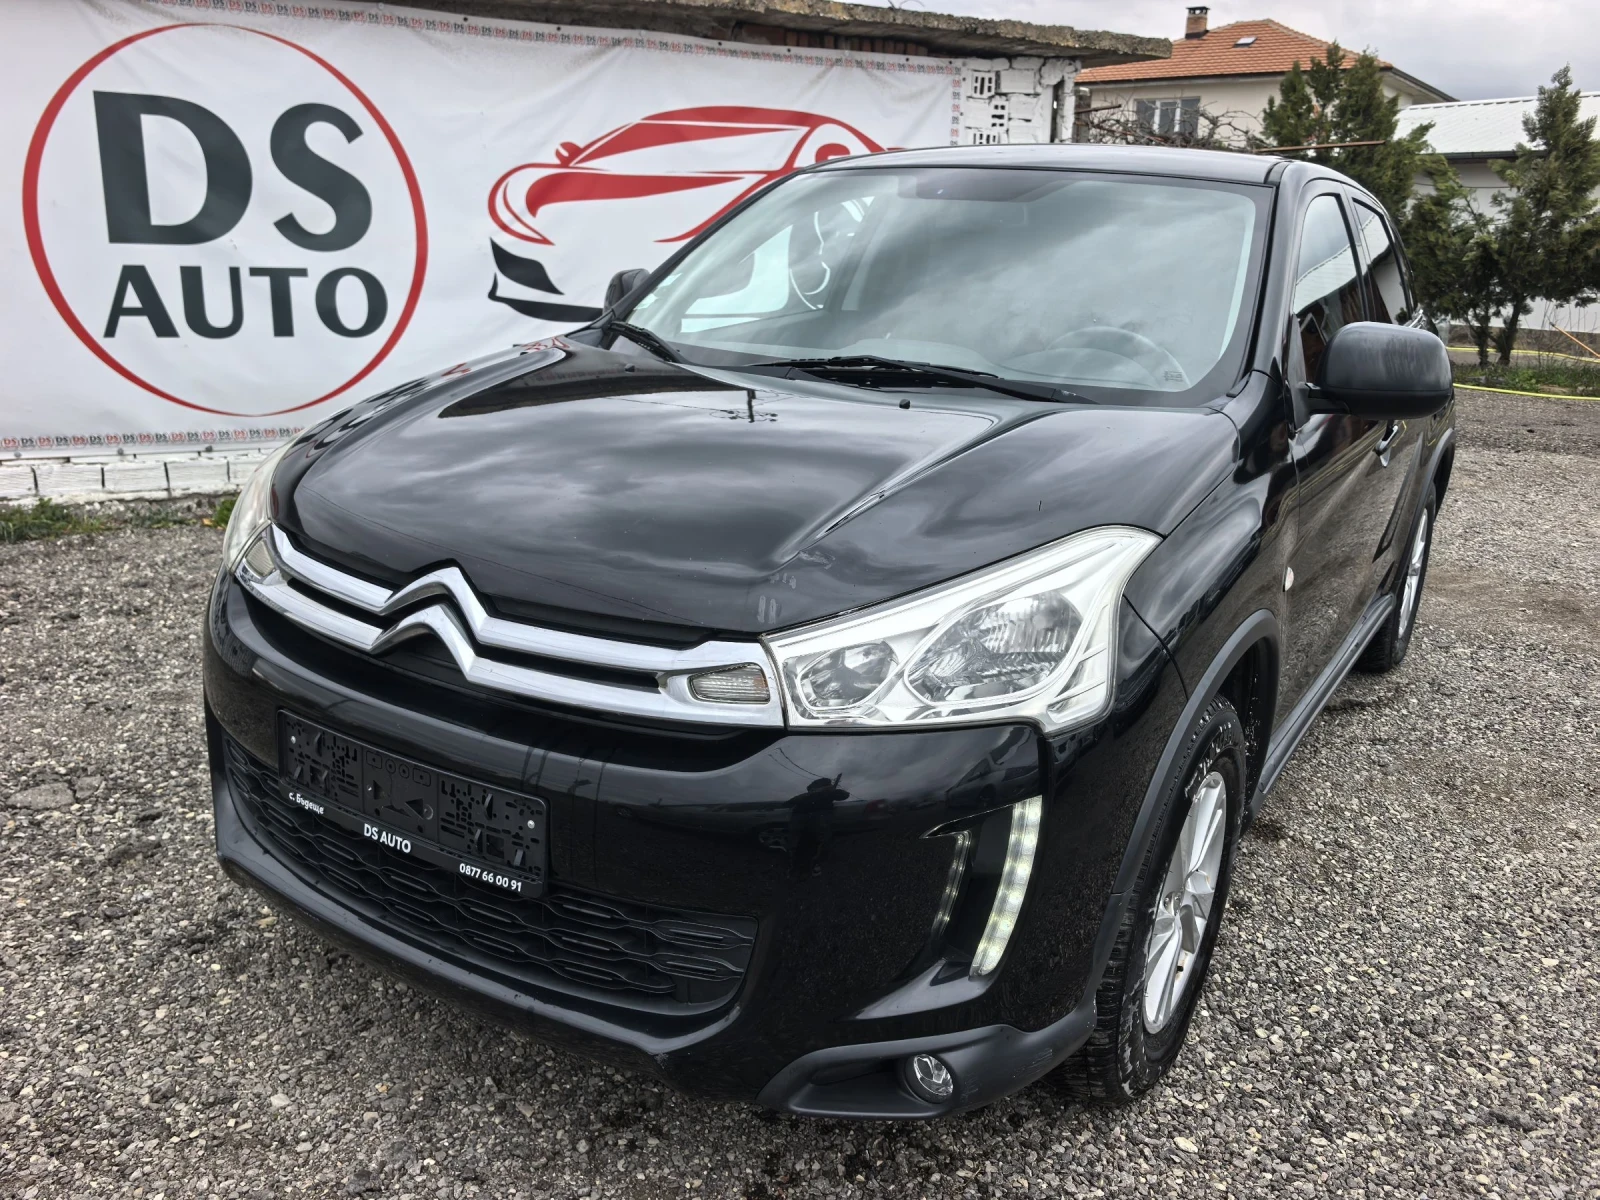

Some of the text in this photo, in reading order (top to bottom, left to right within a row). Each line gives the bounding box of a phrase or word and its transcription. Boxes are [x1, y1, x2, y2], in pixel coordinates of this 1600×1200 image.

[93, 90, 372, 252] DS
[103, 264, 388, 339] AUTO
[364, 823, 412, 853] DS AUTO
[460, 863, 522, 892] 0877 66 00 91
